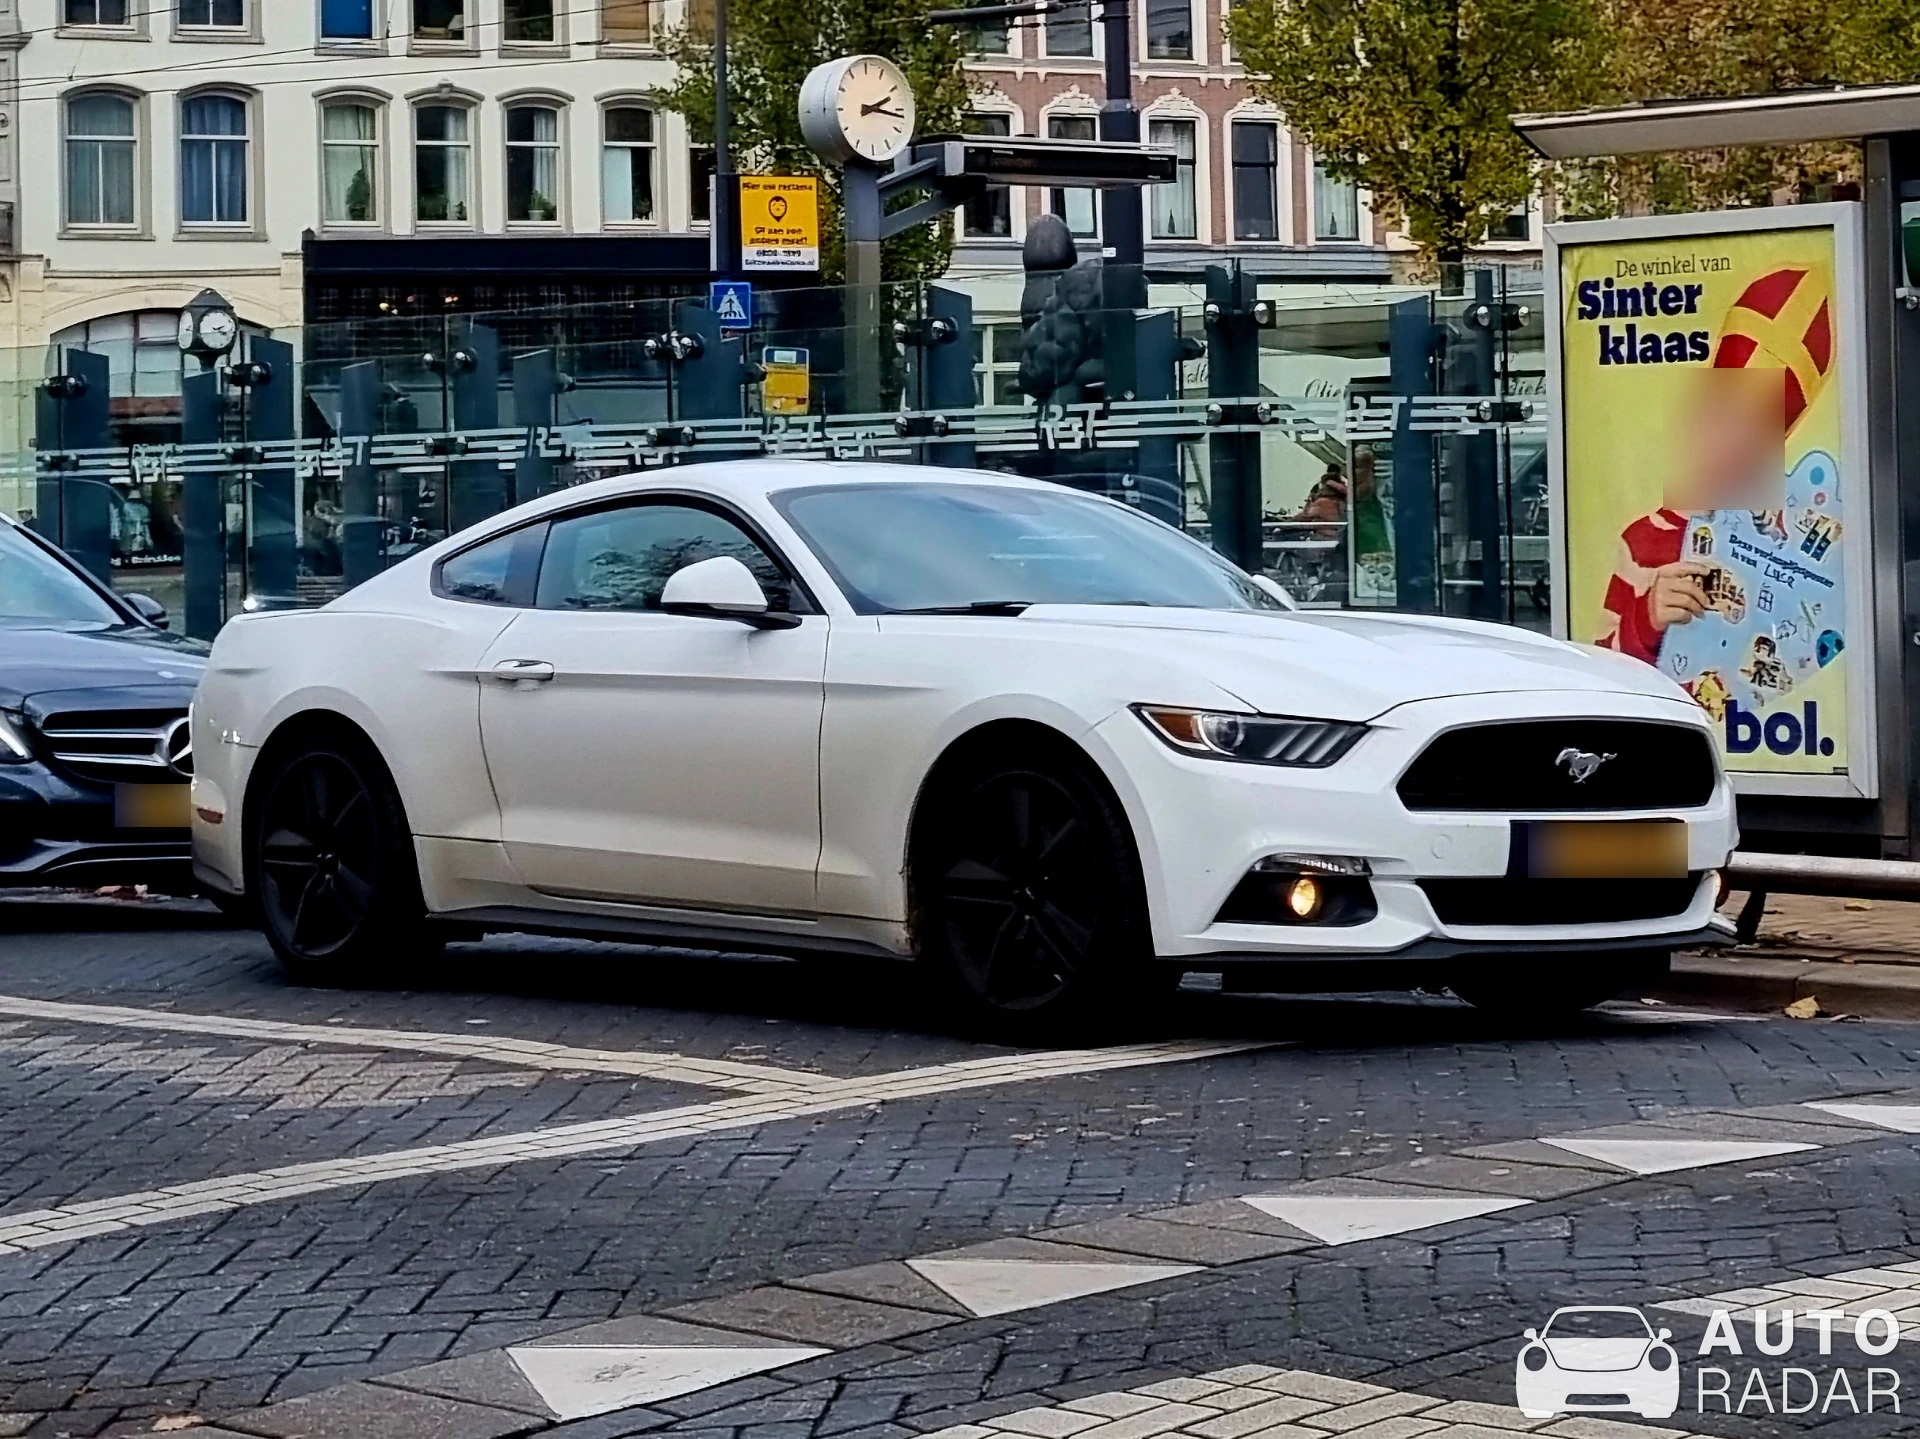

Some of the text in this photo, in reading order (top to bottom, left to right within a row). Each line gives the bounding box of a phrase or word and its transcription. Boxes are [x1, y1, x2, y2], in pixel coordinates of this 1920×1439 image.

[1617, 253, 1732, 278] De winkel van
[1577, 277, 1703, 321] Sinter
[1598, 323, 1711, 366] klaas
[1726, 700, 1835, 758] bol.
